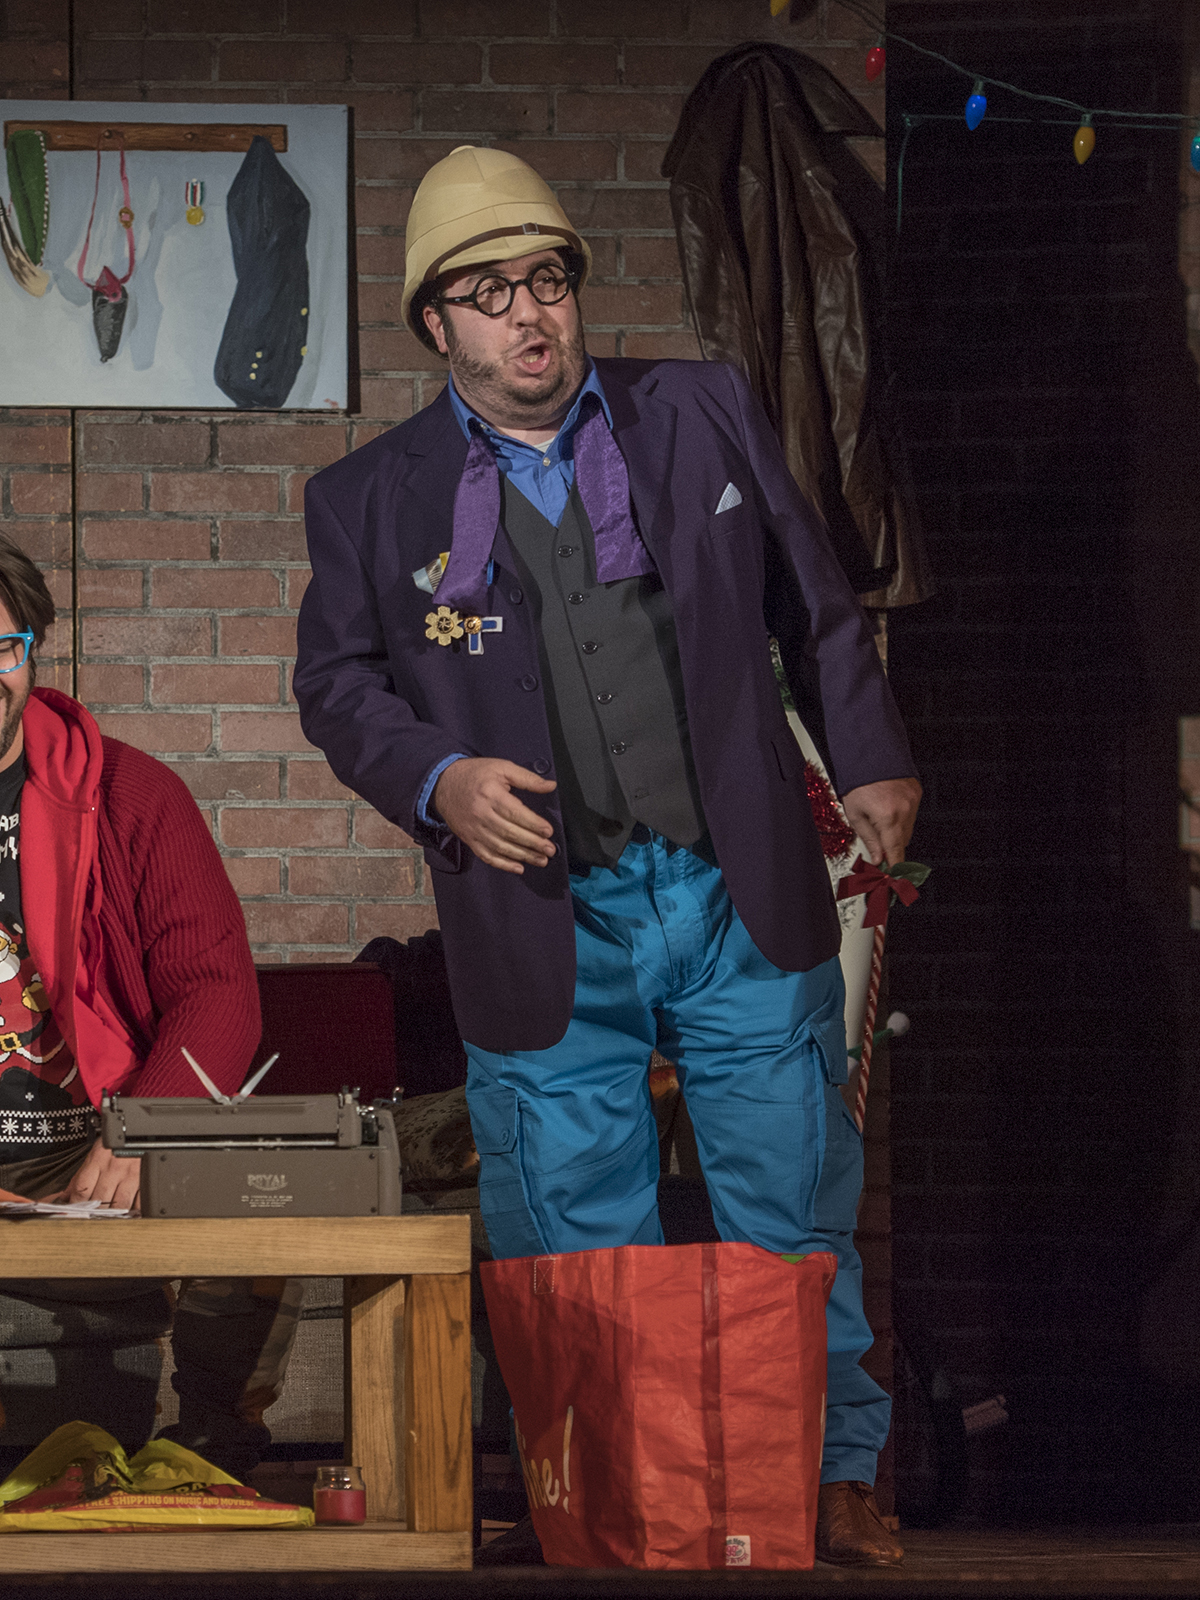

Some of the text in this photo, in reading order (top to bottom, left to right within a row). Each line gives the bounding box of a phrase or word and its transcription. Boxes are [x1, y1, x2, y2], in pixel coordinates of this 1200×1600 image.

[112, 1496, 162, 1506] SHIPPING
[163, 1496, 175, 1505] ON
[176, 1496, 202, 1505] MUSIC
[203, 1497, 219, 1505] AND
